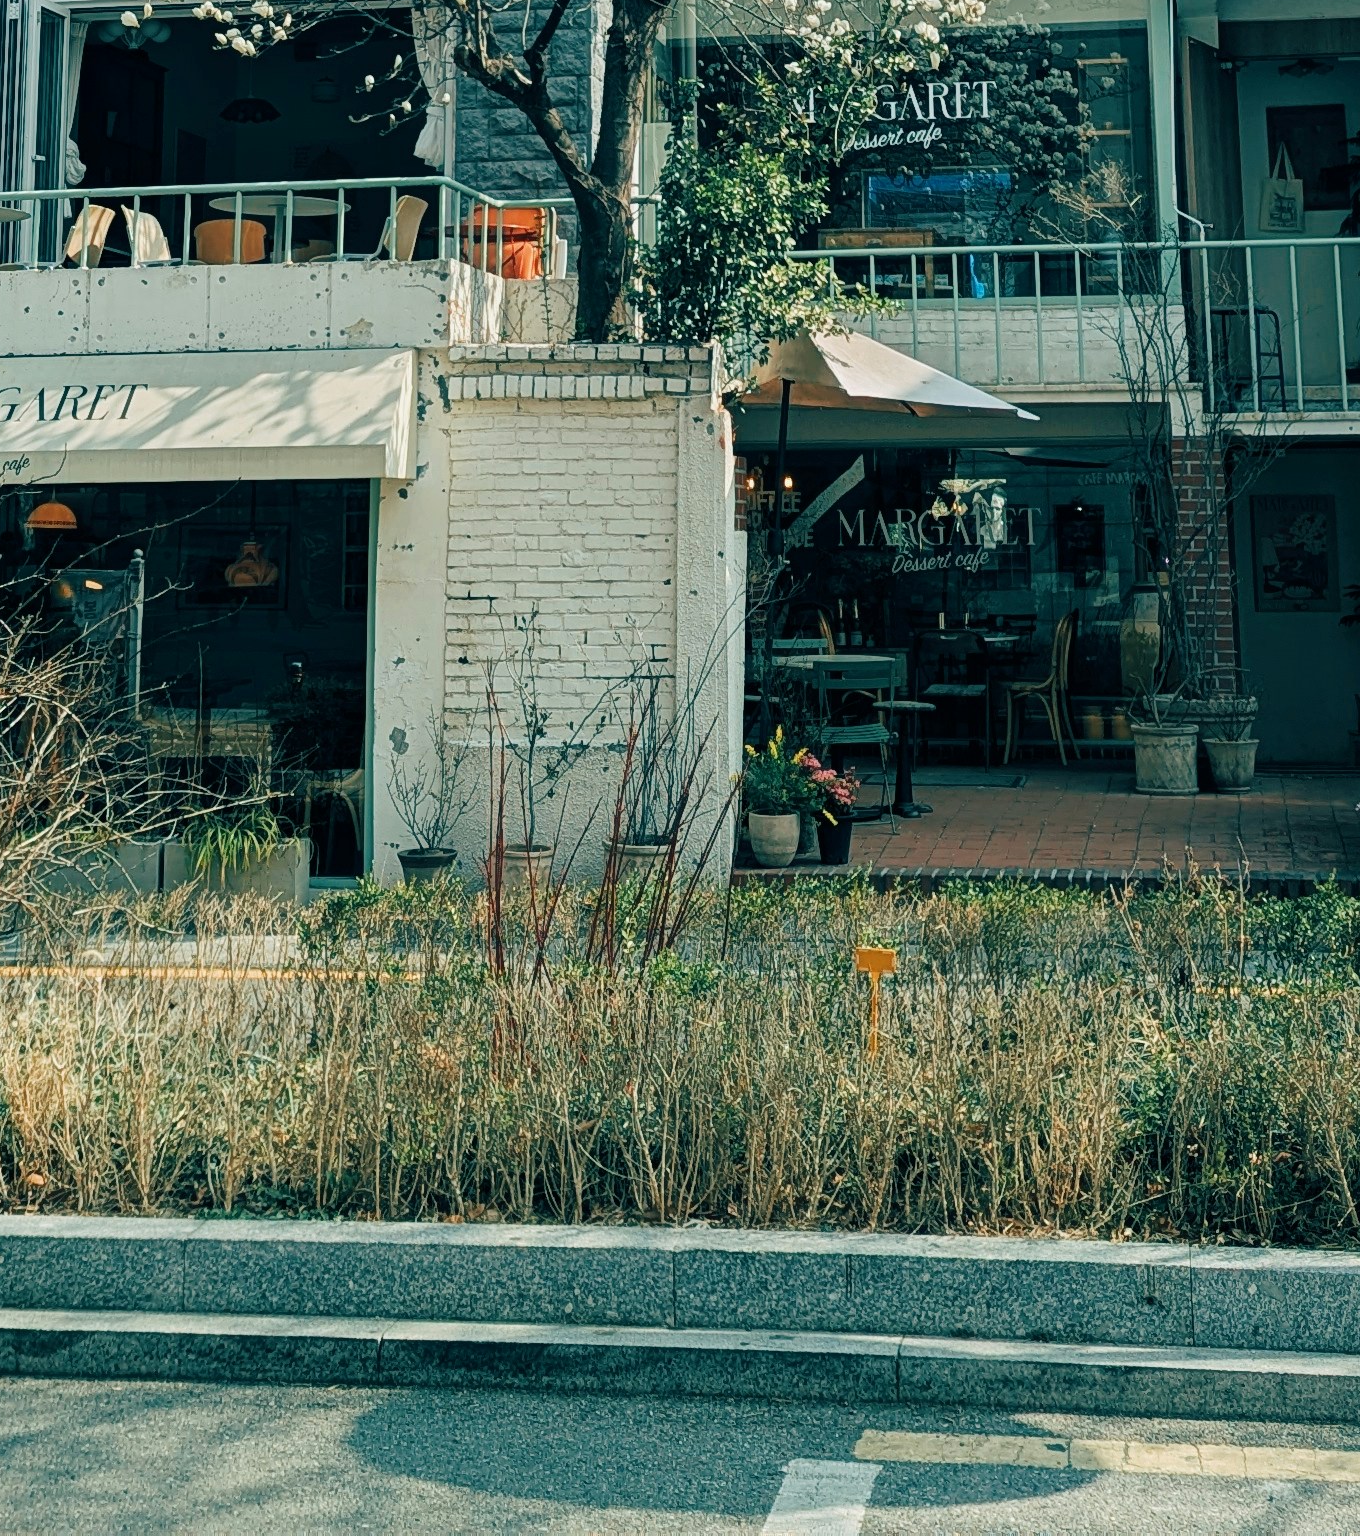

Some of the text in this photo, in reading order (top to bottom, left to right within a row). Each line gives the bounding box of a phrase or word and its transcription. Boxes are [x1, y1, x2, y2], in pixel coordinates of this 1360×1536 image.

[907, 121, 943, 149] cafe
[3, 454, 31, 477] cafe
[837, 507, 1042, 547] MARGARET
[892, 546, 990, 574] Dessert cafe
